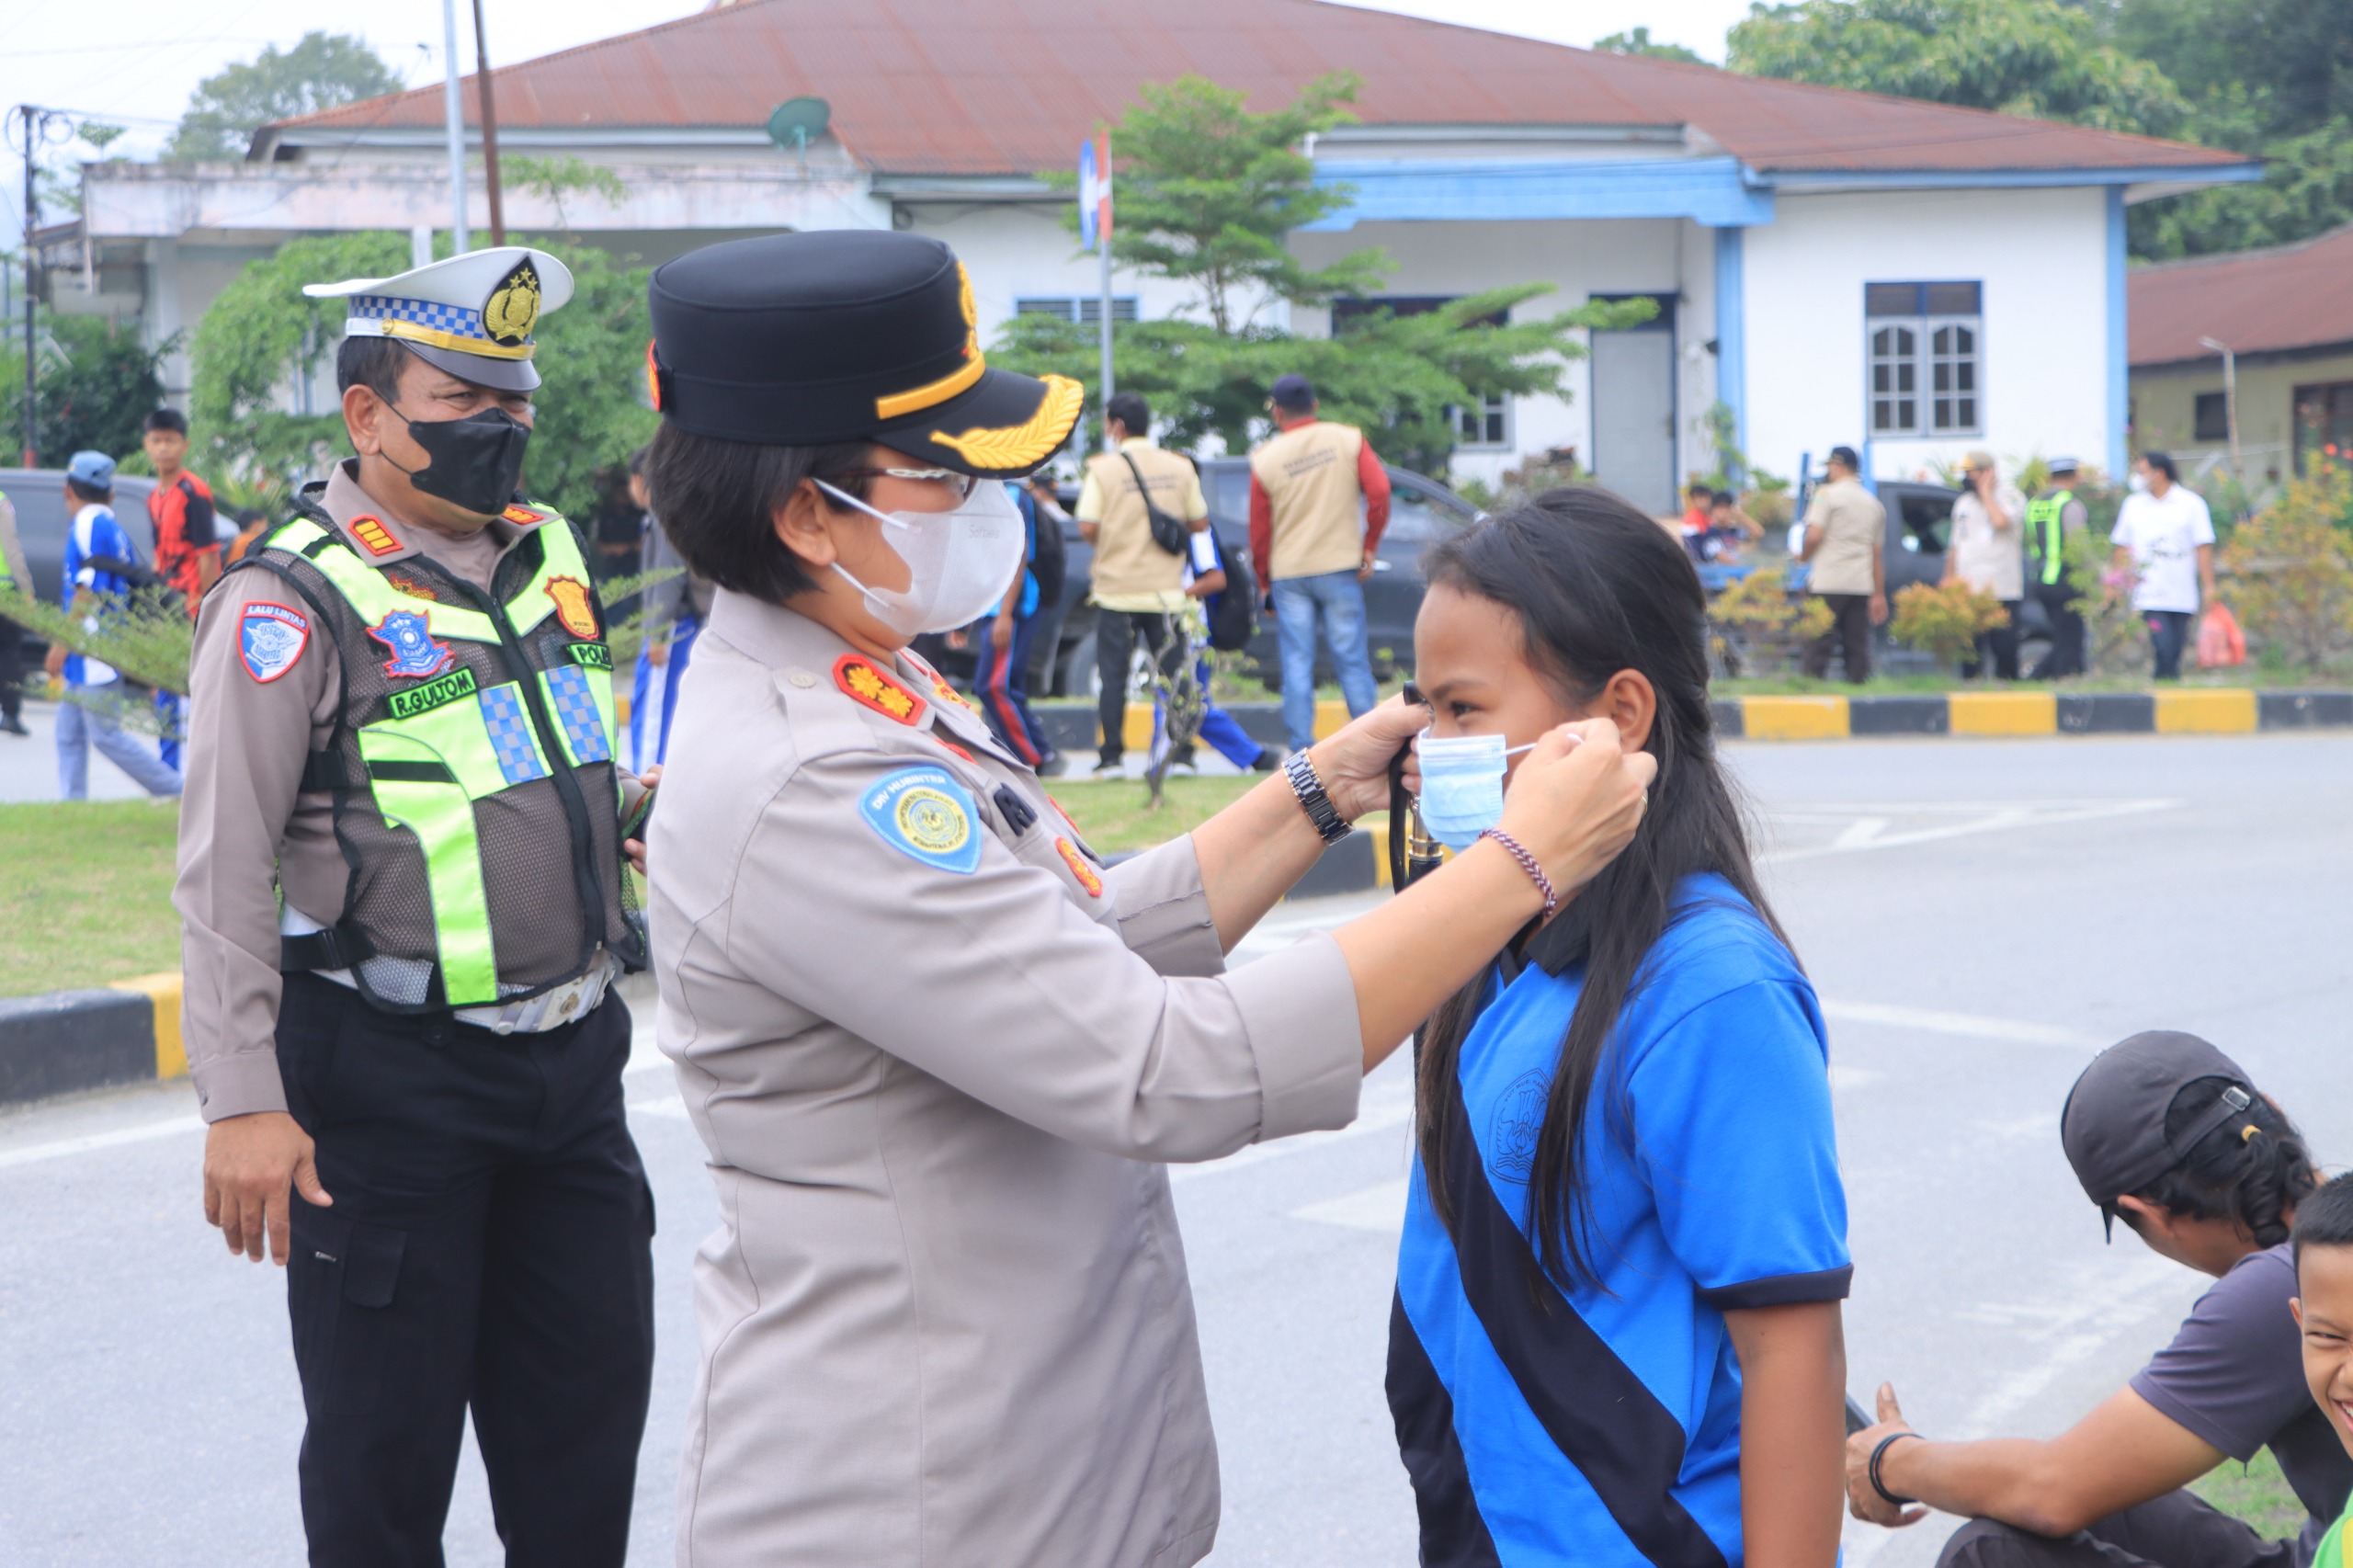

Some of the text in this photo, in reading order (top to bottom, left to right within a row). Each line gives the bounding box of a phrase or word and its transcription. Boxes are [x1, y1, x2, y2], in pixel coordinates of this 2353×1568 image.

[246, 604, 307, 629] LALU LINTAS
[394, 671, 472, 715] R.GULTOM
[871, 789, 891, 810] DIV
[887, 774, 948, 793] HUBINTER
